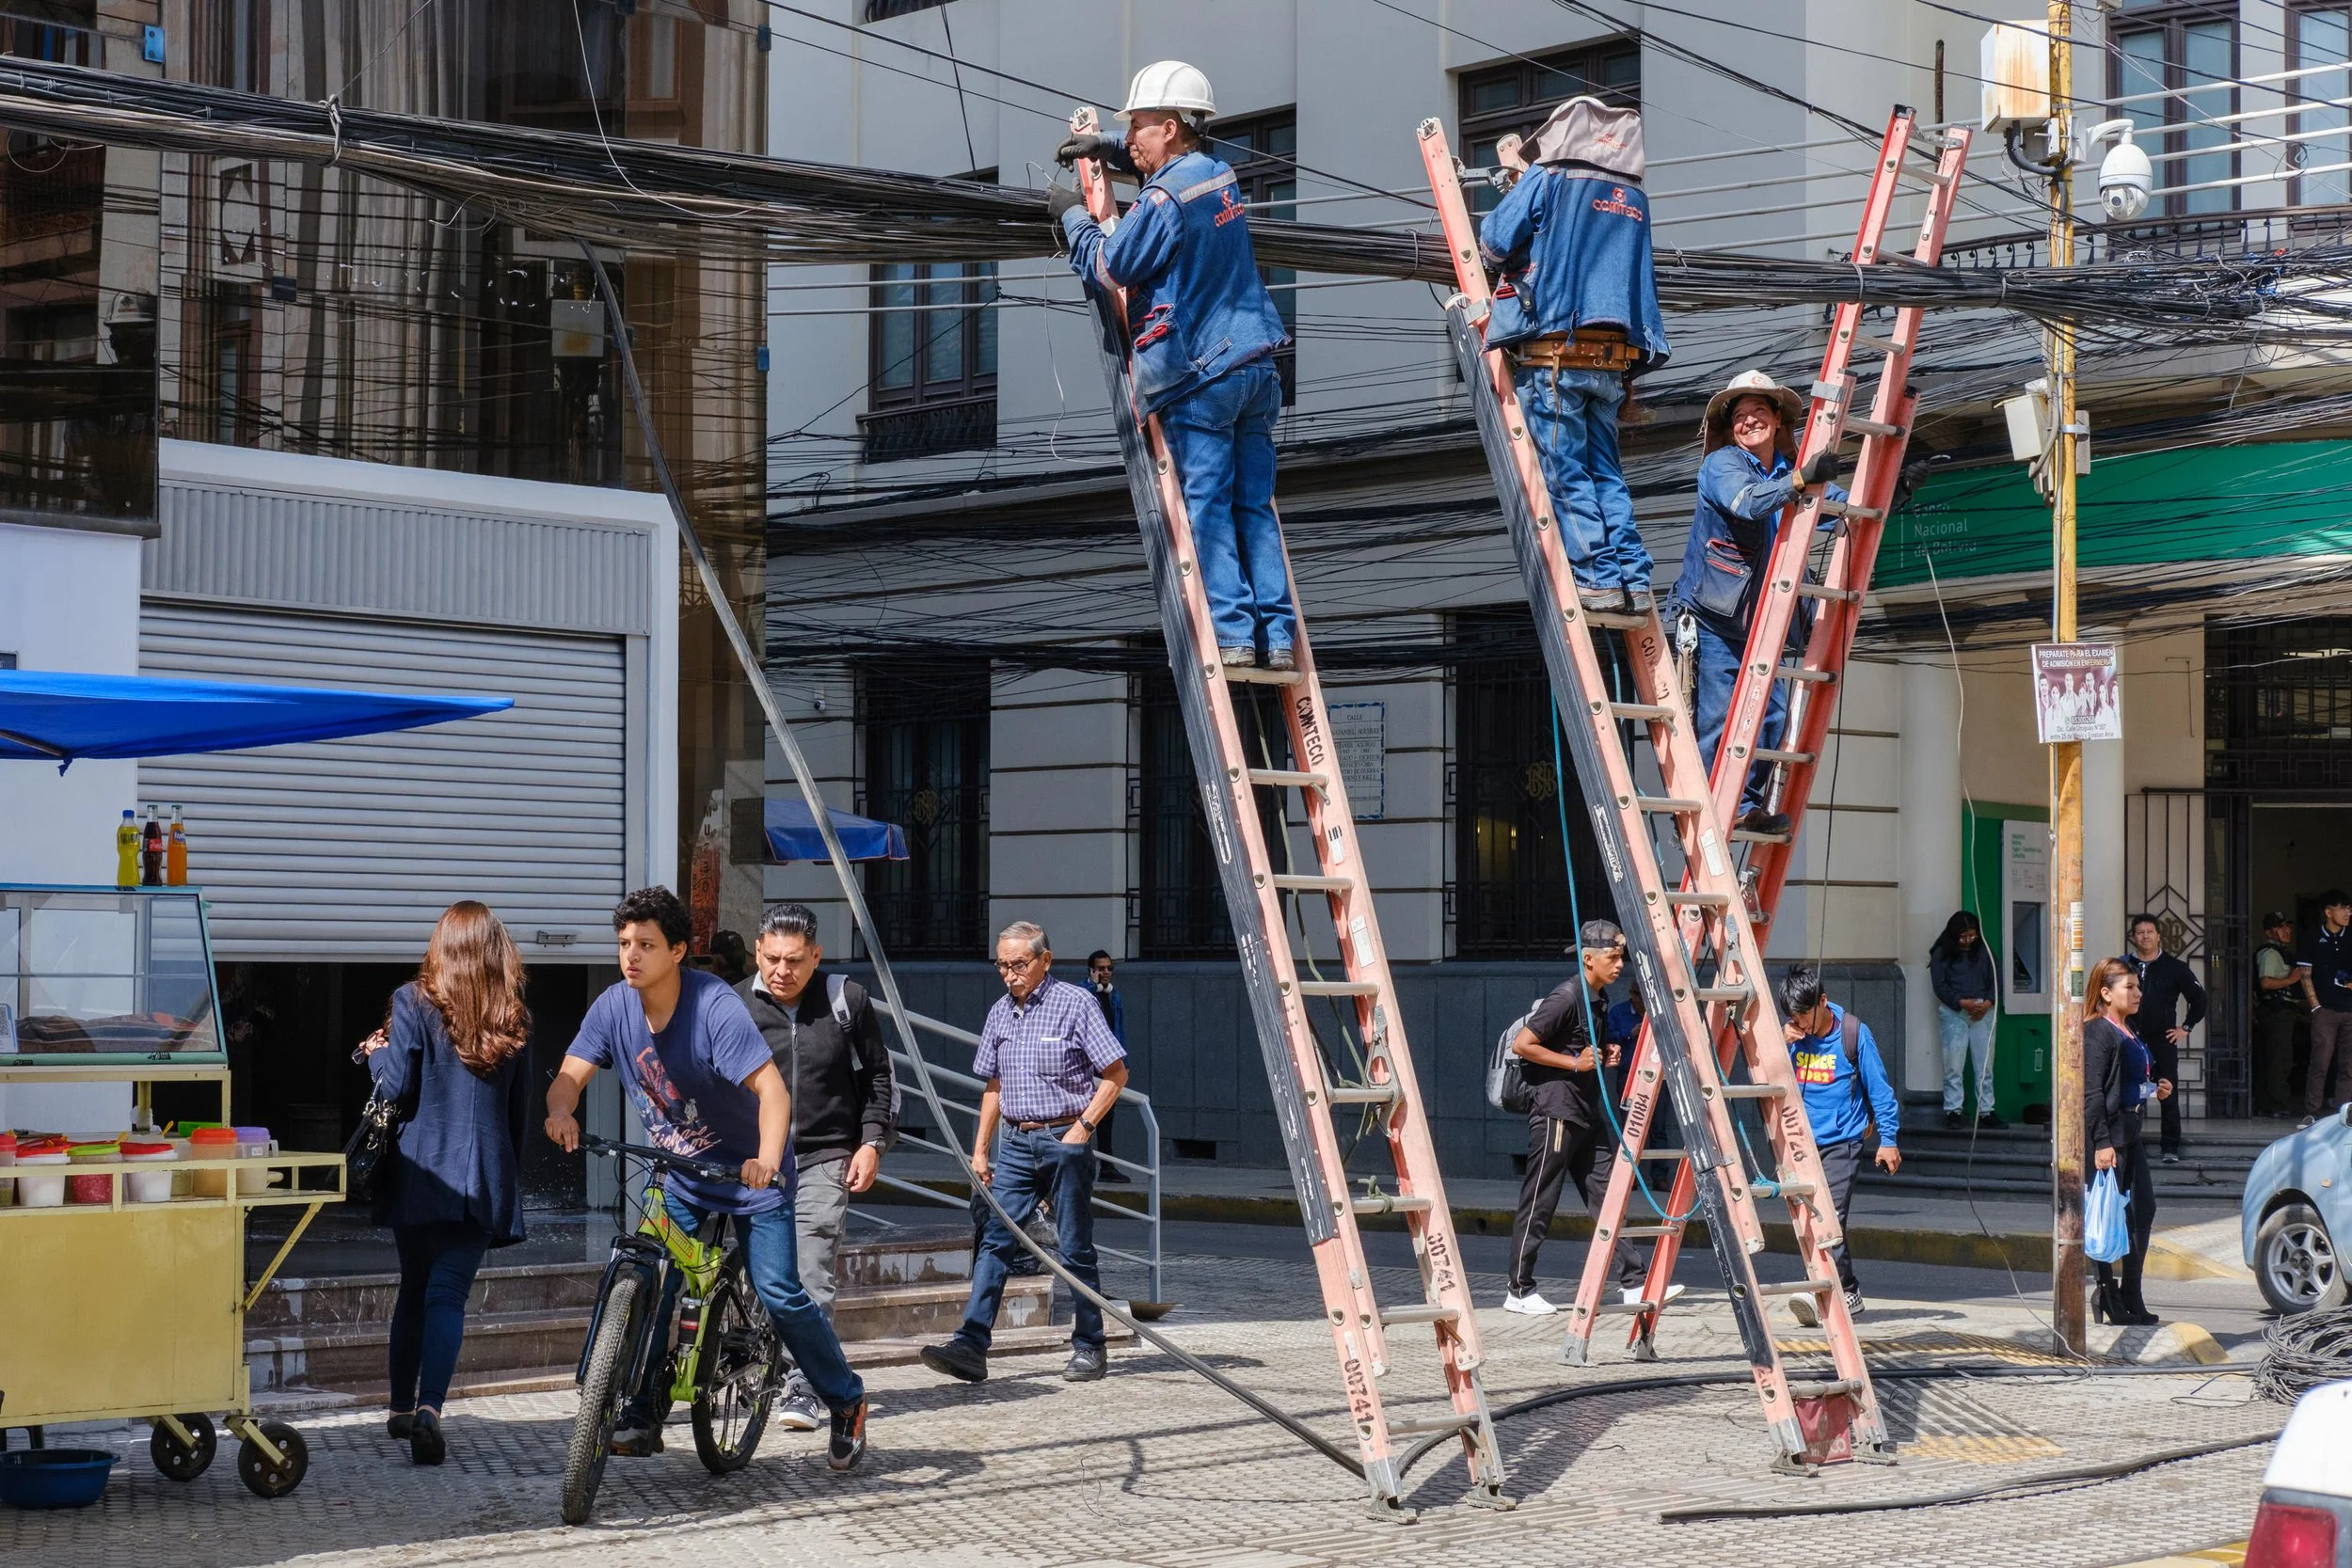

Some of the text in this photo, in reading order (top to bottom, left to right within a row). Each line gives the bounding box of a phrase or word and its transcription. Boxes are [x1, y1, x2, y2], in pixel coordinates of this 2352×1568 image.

[1915, 518, 1968, 537] Nacional
[1796, 1051, 1837, 1069] SINCE
[1800, 1069, 1830, 1082] 1982
[1627, 1093, 1650, 1138] 01084
[1344, 1358, 1375, 1424] 00741
